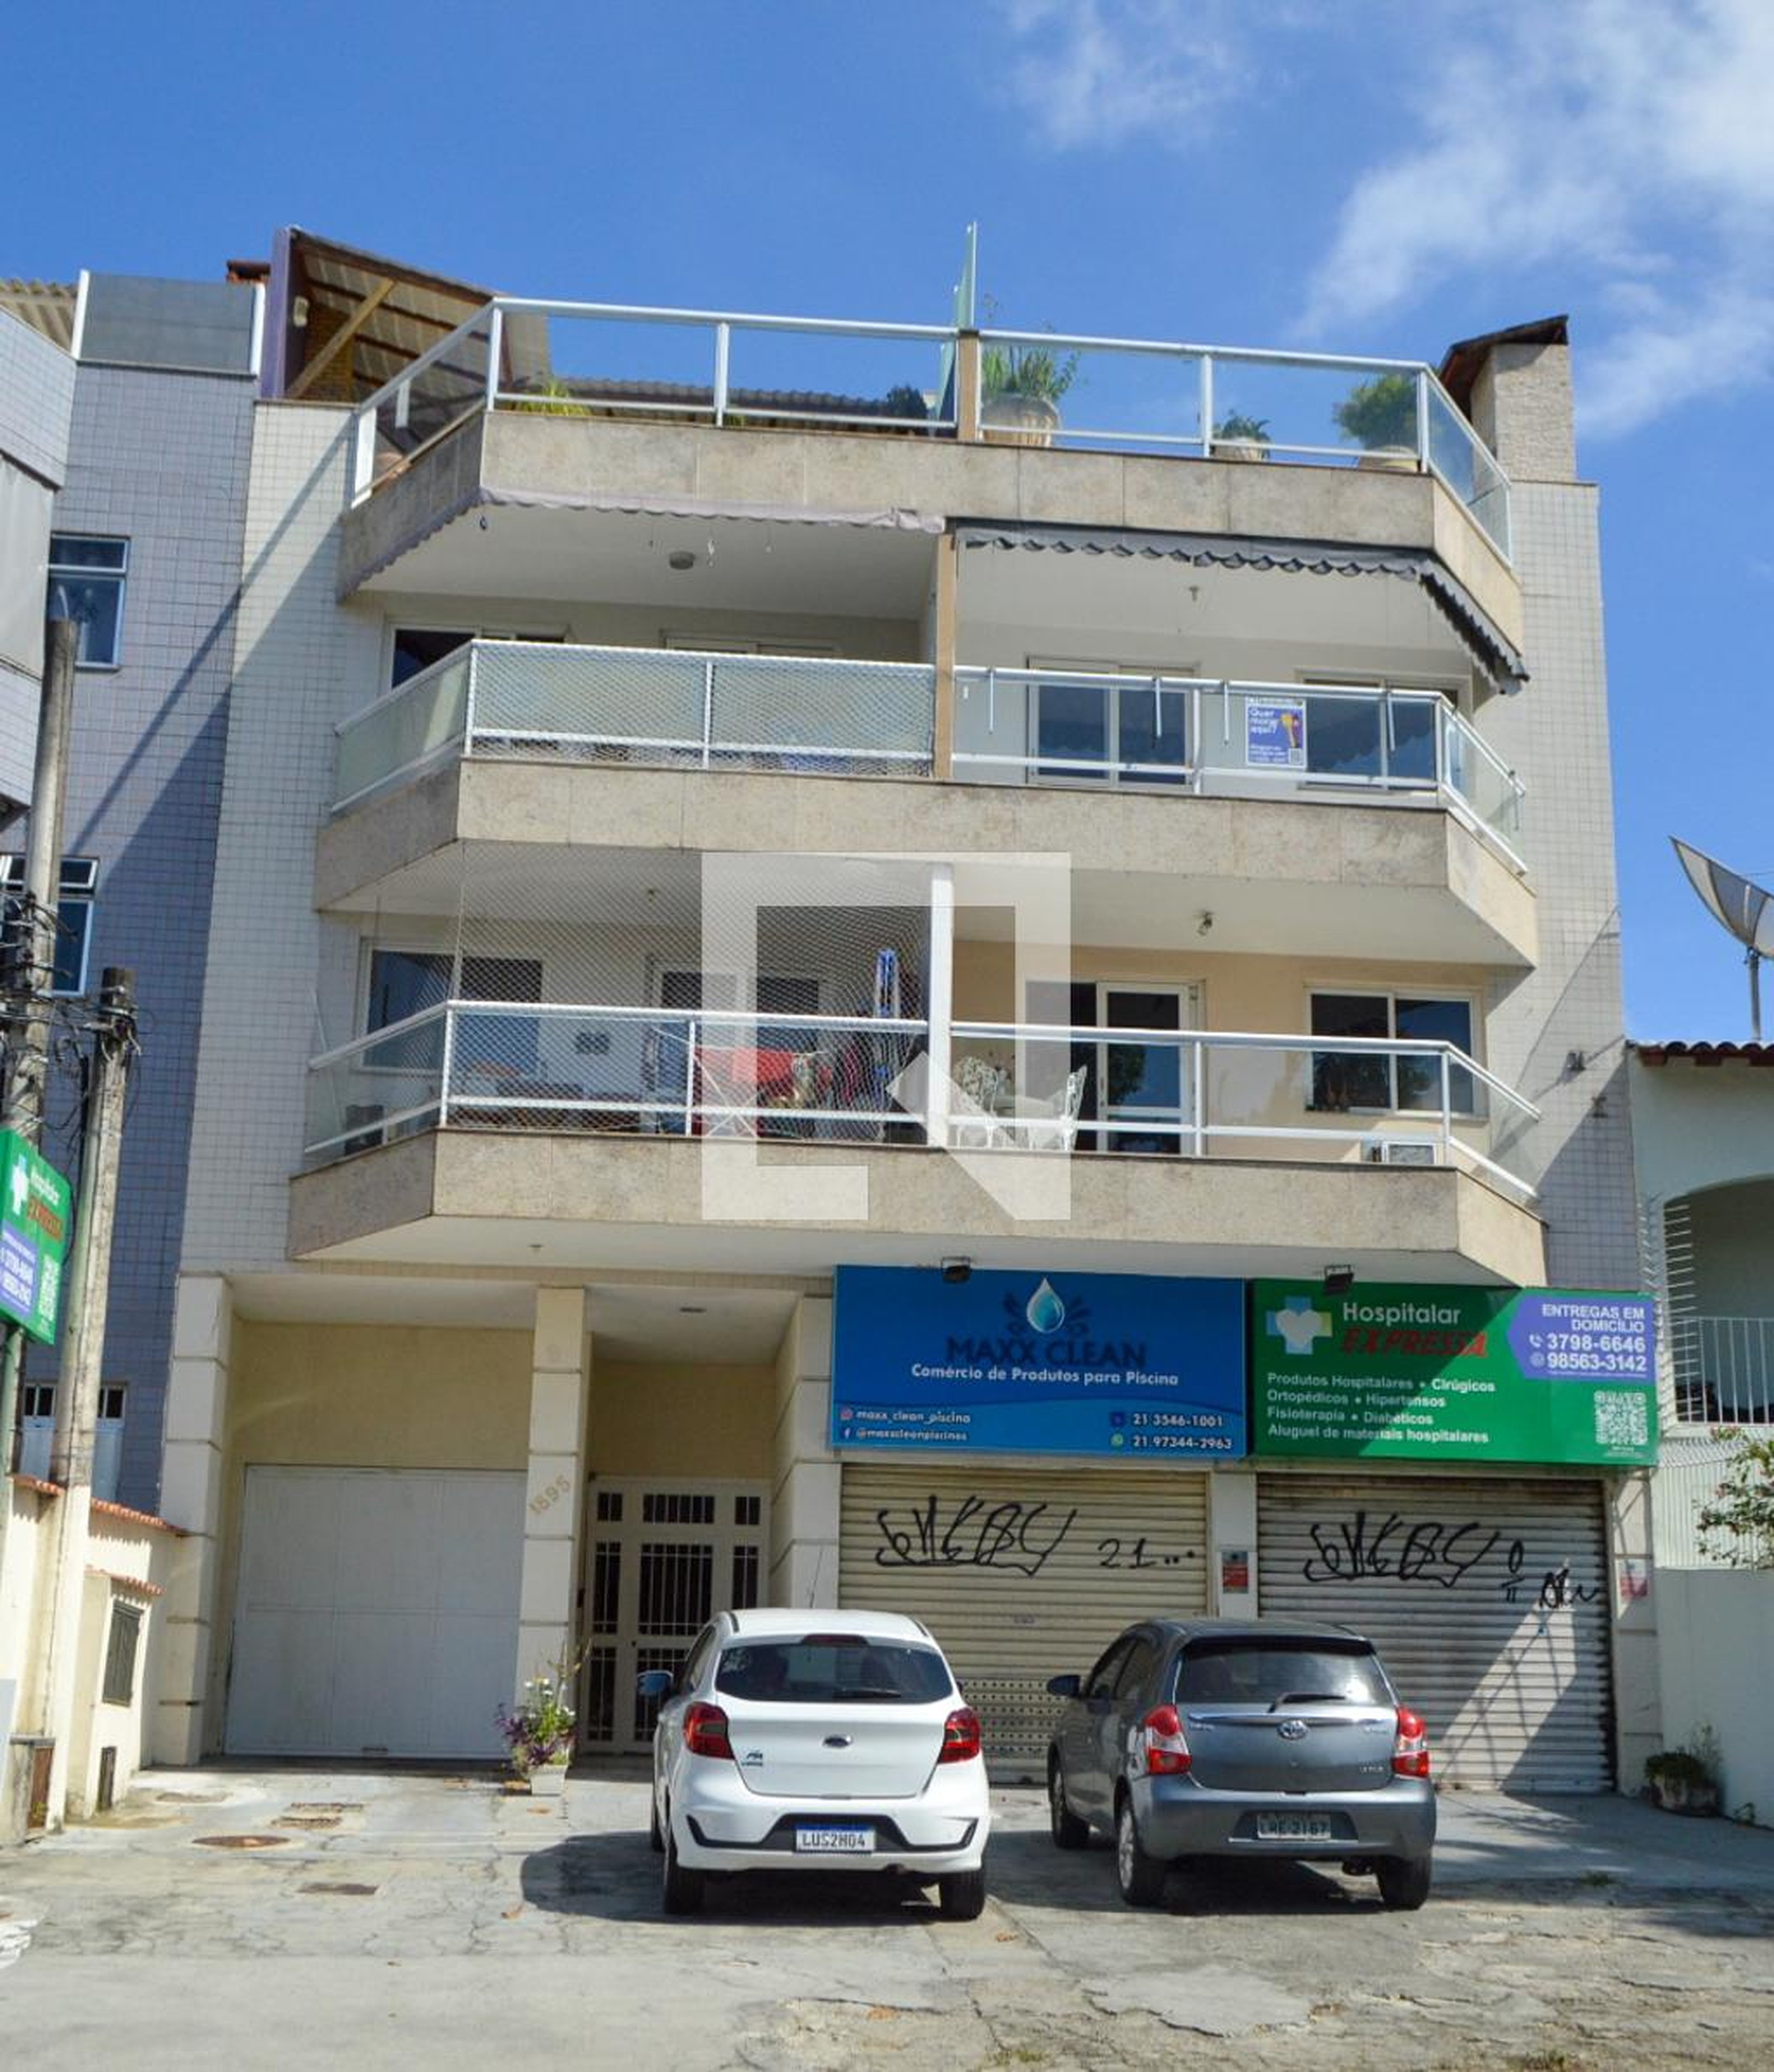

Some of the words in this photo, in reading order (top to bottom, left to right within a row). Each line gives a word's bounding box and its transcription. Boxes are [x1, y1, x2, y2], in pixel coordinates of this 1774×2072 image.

[1343, 1302, 1461, 1327] Hospitalar
[1543, 1304, 1618, 1318] ENTREGAS
[1623, 1307, 1645, 1319] EM
[1572, 1318, 1645, 1333] DOMICÍLIO
[1342, 1326, 1488, 1358] EXPRESSA
[1547, 1333, 1646, 1353] 3798-6646
[946, 1337, 1037, 1366] MAXX
[1045, 1340, 1146, 1368] CLEAN
[1547, 1351, 1647, 1372] 98563-3142
[911, 1363, 983, 1379] Comércio
[988, 1365, 1007, 1380] de
[1012, 1366, 1080, 1382] Produtos
[1084, 1372, 1120, 1385] para
[1126, 1371, 1179, 1385] Piscina
[1267, 1373, 1329, 1386] Produtos
[1331, 1375, 1414, 1389] Hospitalares
[1267, 1389, 1349, 1404] Ortopédicos
[1366, 1393, 1446, 1408] Hipertensos
[1133, 1413, 1147, 1426] 21
[1268, 1406, 1345, 1422] Fisioterapia
[1133, 1435, 1148, 1447] 21
[1269, 1424, 1319, 1439] Aluguel
[1323, 1427, 1339, 1438] de
[1343, 1428, 1403, 1440] materiais
[1406, 1428, 1488, 1442] hospitalares
[803, 1832, 865, 1847] LUS2H04
